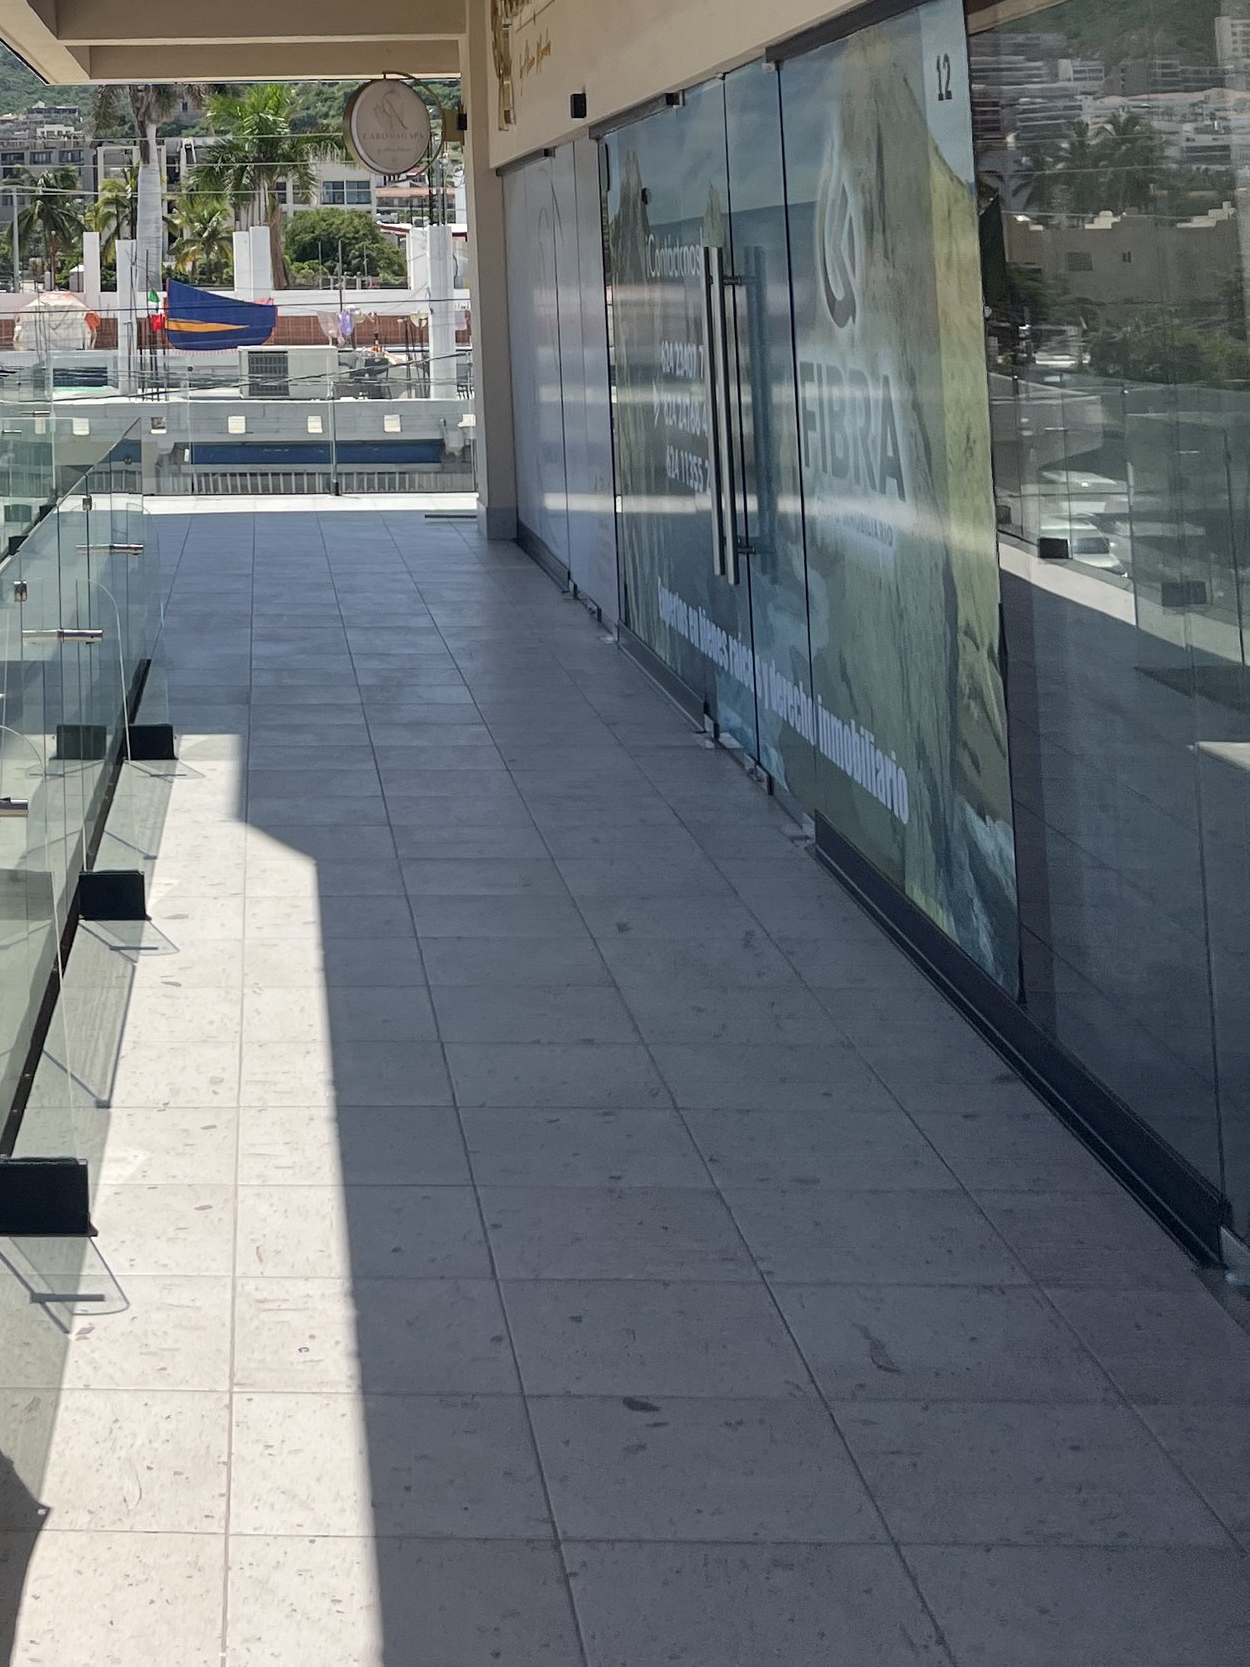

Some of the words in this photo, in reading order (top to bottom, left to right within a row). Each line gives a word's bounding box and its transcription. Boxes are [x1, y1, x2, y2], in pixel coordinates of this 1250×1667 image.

[936, 54, 953, 101] 12
[800, 361, 906, 502] FIBRA
[817, 693, 909, 825] inmobiliario
